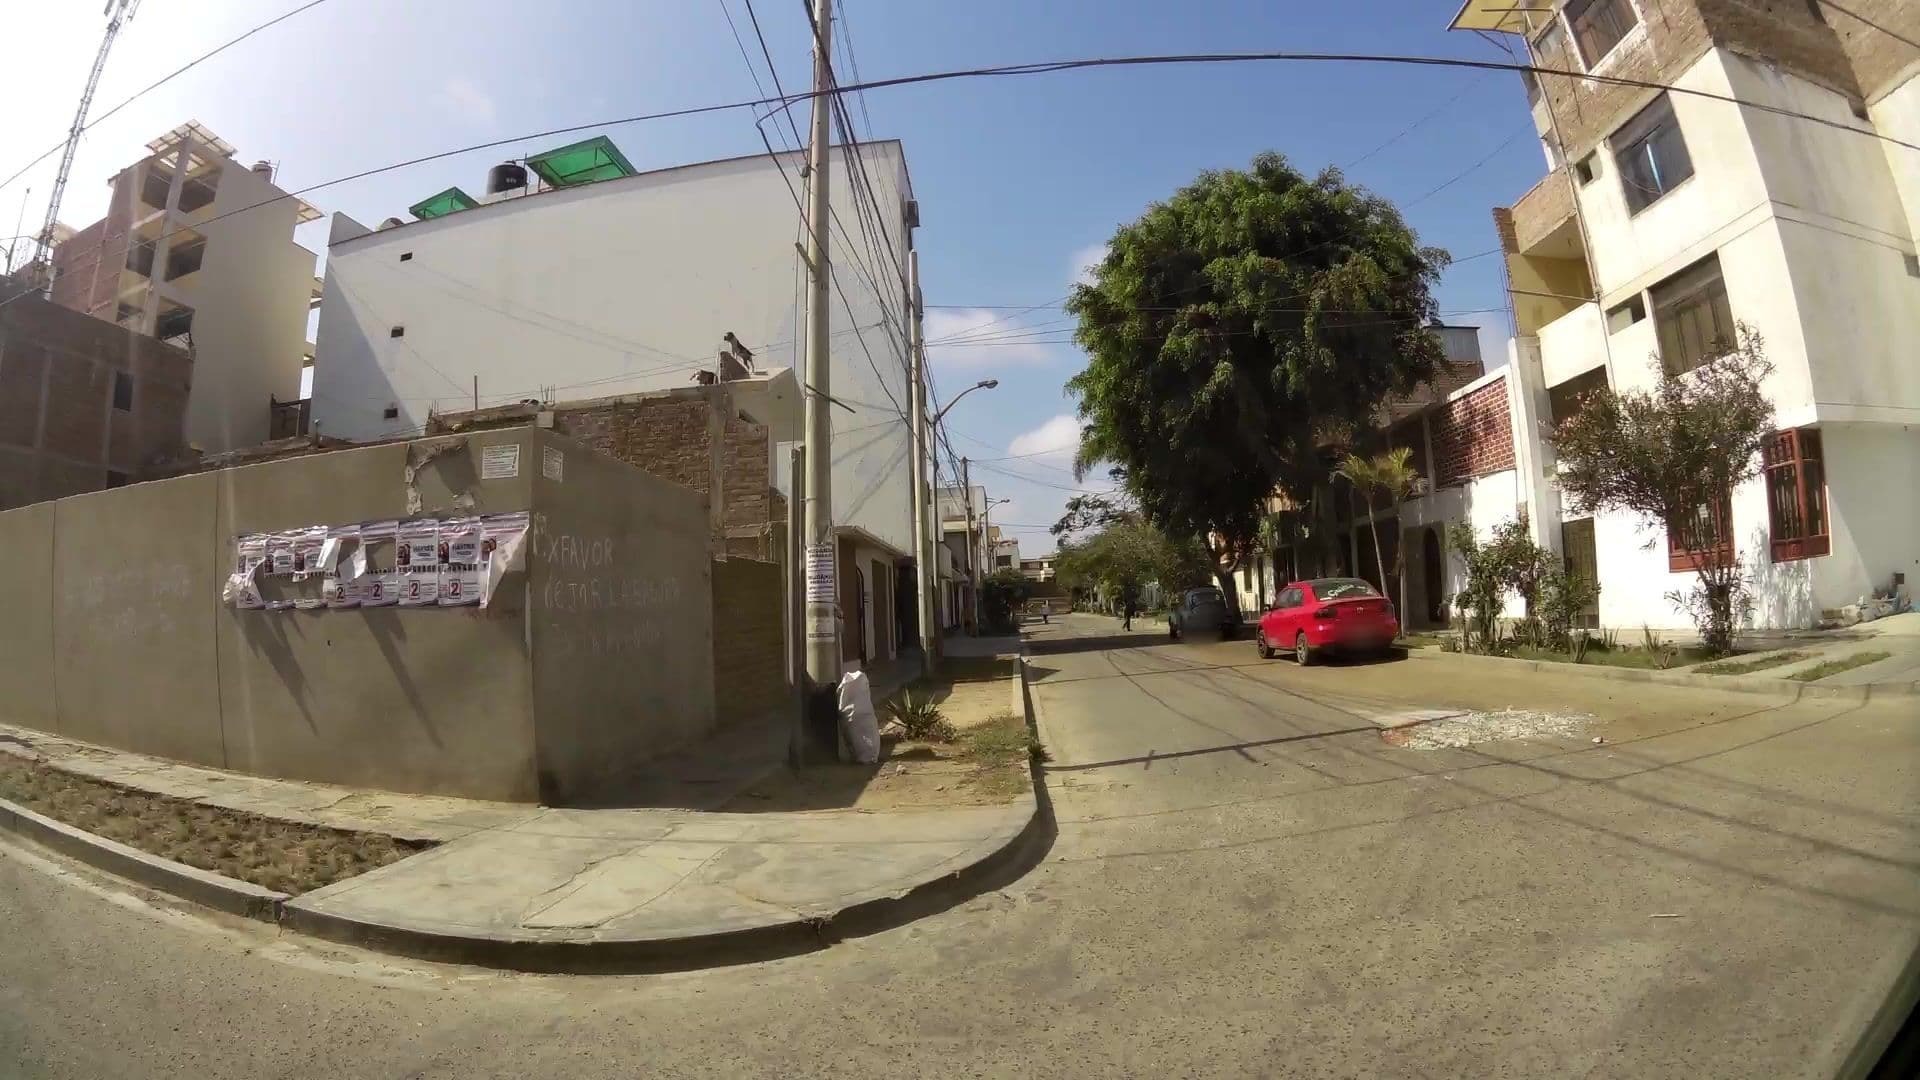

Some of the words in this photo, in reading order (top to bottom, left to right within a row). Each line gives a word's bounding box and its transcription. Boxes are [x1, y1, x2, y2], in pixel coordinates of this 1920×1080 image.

[336, 586, 345, 600] 2
[373, 583, 381, 597] 2
[411, 582, 419, 597] 2
[450, 582, 460, 596] 2
